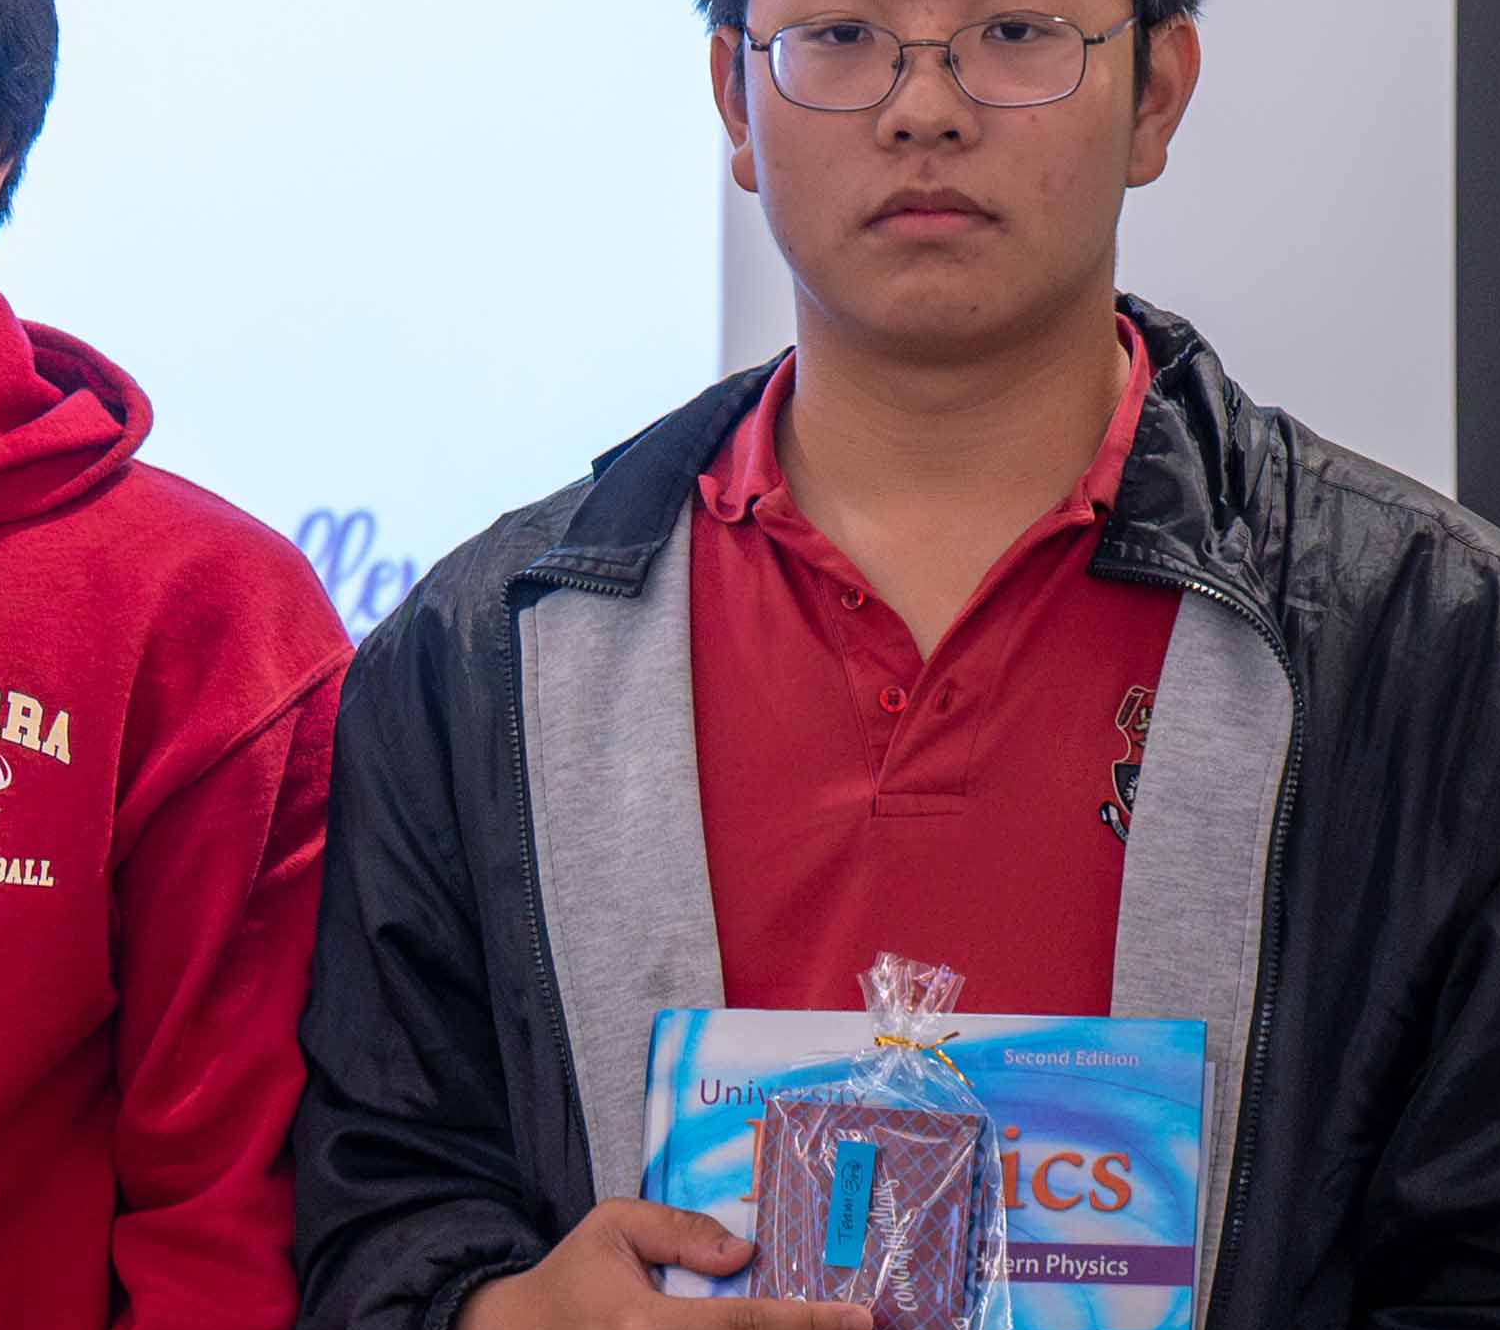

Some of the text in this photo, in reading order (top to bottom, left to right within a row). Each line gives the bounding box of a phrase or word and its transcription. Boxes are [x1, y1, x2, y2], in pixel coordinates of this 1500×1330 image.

[1003, 1047, 1140, 1068] Second Edition
[1046, 1253, 1130, 1280] Physics
